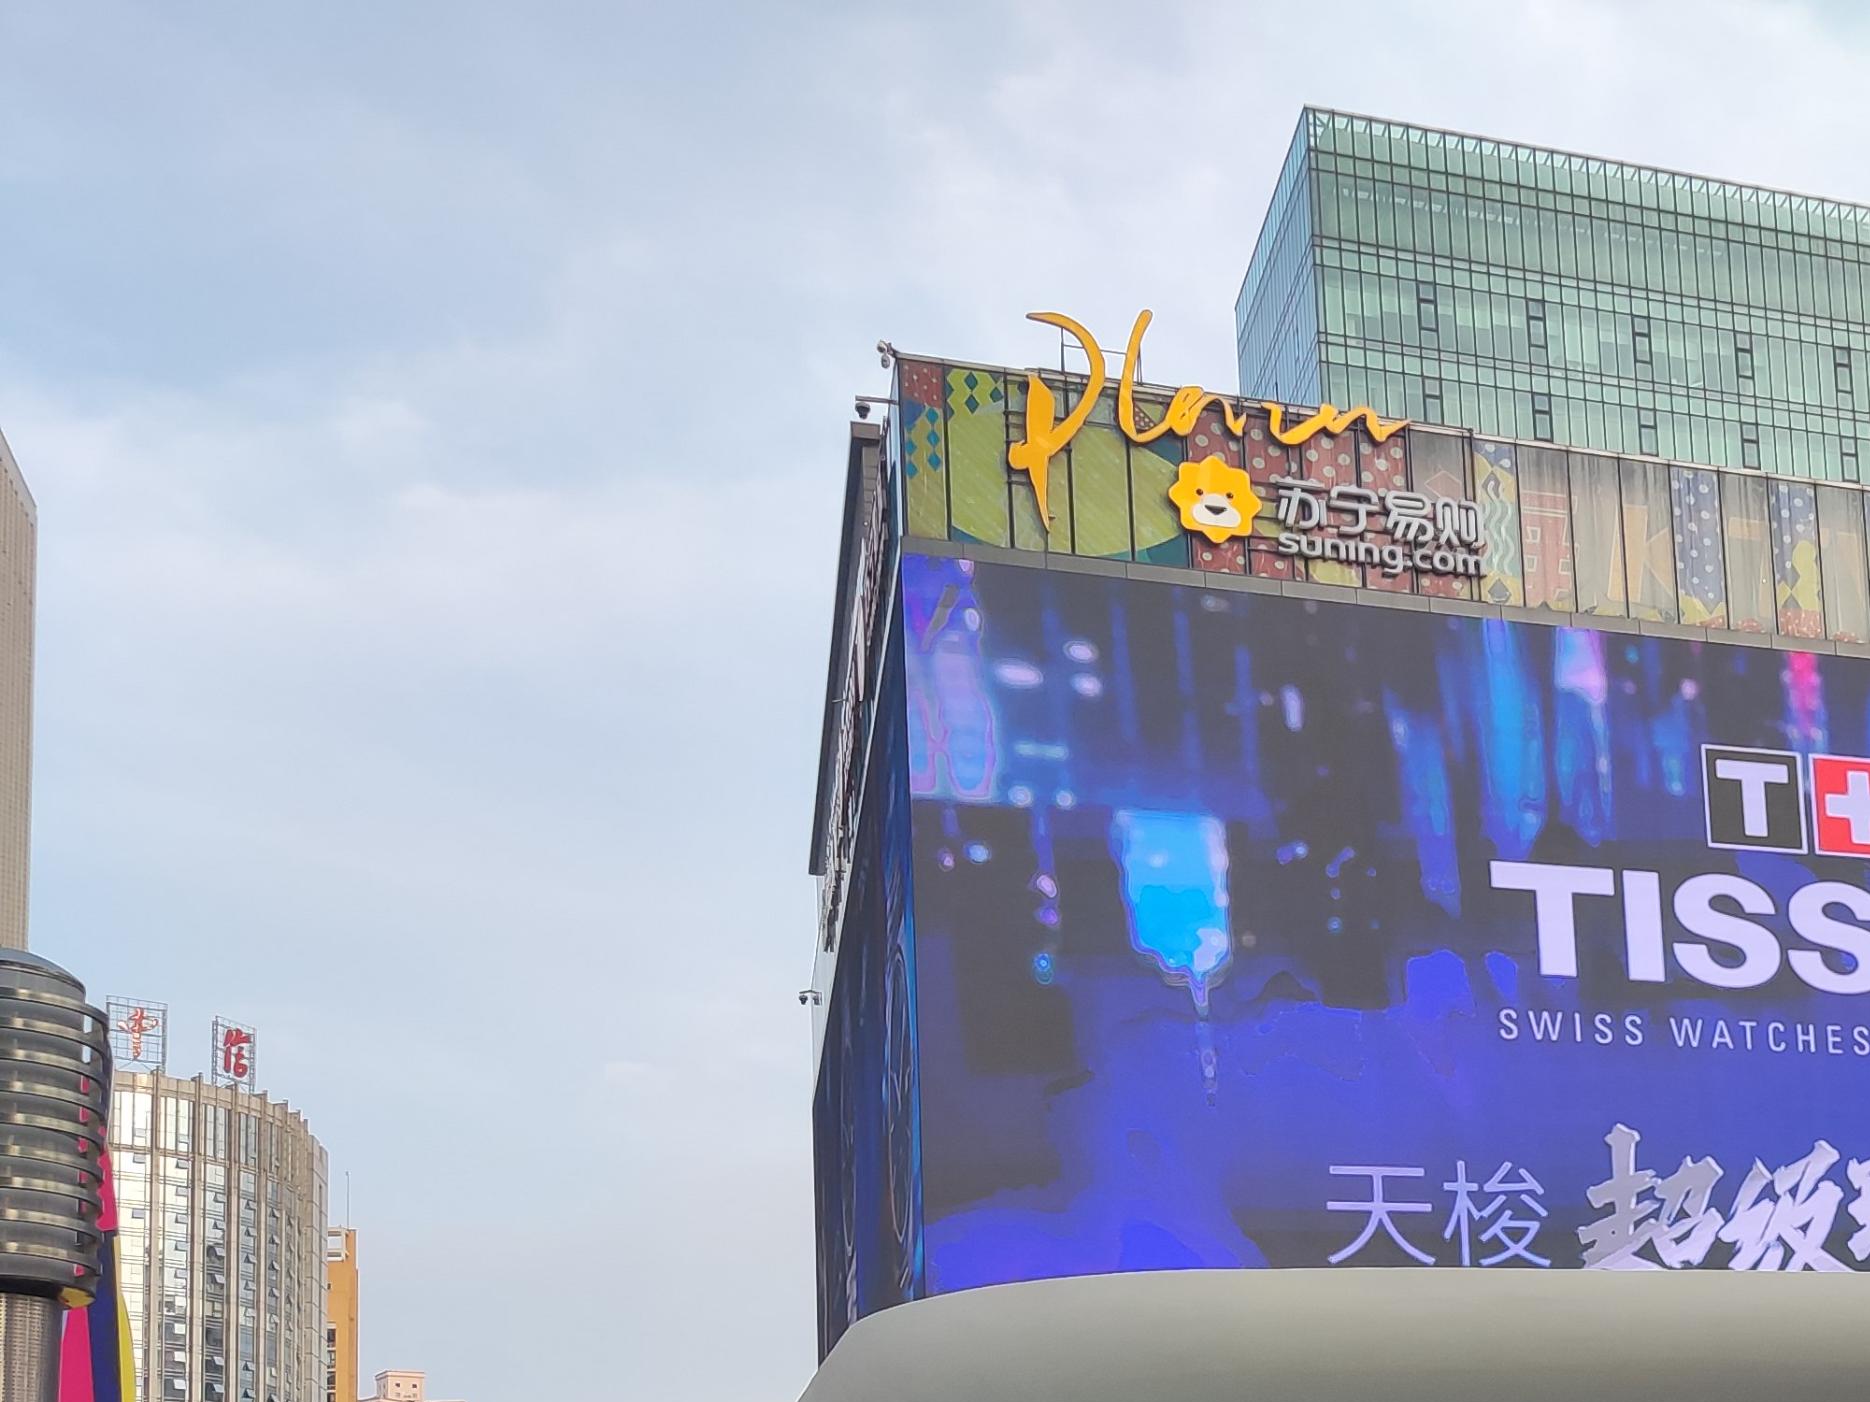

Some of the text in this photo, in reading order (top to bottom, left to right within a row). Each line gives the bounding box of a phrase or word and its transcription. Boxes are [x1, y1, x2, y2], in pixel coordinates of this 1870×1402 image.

[1275, 475, 1487, 548] 苏宁易购
[1277, 530, 1488, 577] suning.com
[1498, 1008, 1645, 1046] SWISS
[1325, 1160, 1552, 1269] 天梭
